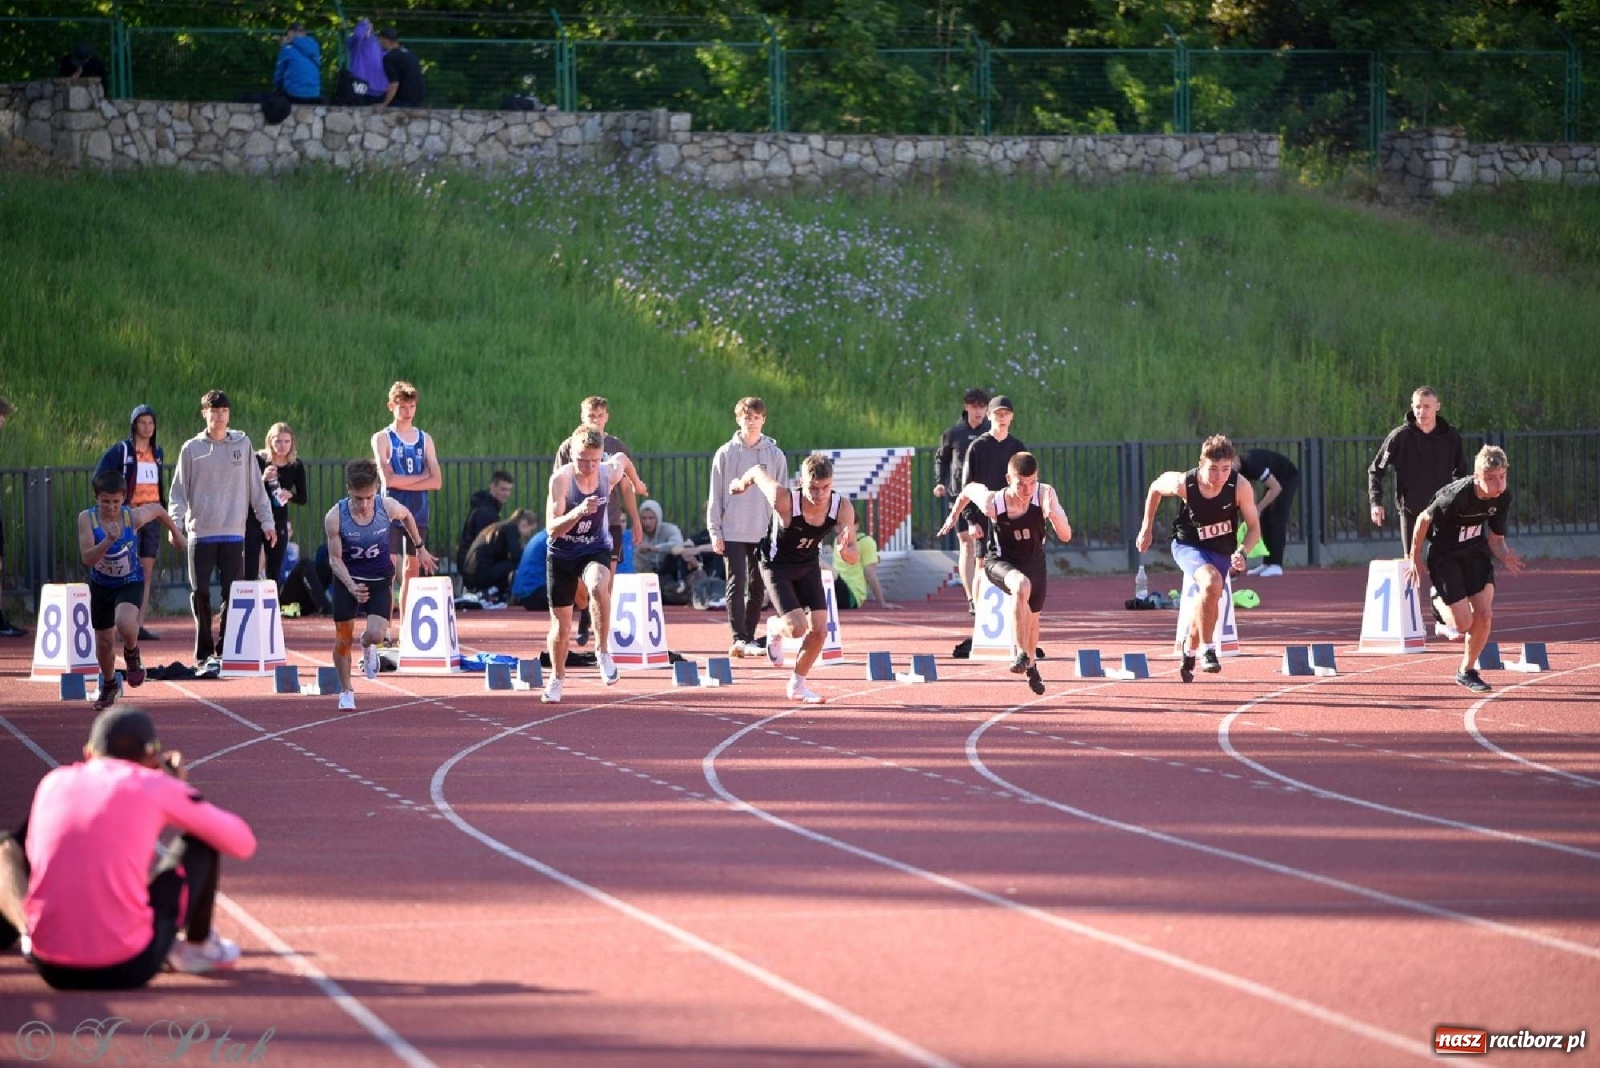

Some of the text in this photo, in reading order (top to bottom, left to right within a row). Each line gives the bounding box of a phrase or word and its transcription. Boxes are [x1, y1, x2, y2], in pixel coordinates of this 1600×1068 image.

[406, 458, 413, 473] 9
[351, 544, 380, 559] 26
[796, 537, 814, 549] 21
[1199, 521, 1231, 539] 100
[42, 603, 62, 659] 8
[72, 602, 92, 659] 8
[232, 598, 255, 654] 7
[263, 598, 277, 654] 7
[411, 596, 438, 651] 6
[447, 595, 456, 651] 6
[613, 592, 637, 647] 5
[647, 592, 661, 647] 5
[981, 586, 1005, 639] 3
[1374, 578, 1391, 631] 1
[1404, 579, 1417, 631] 1
